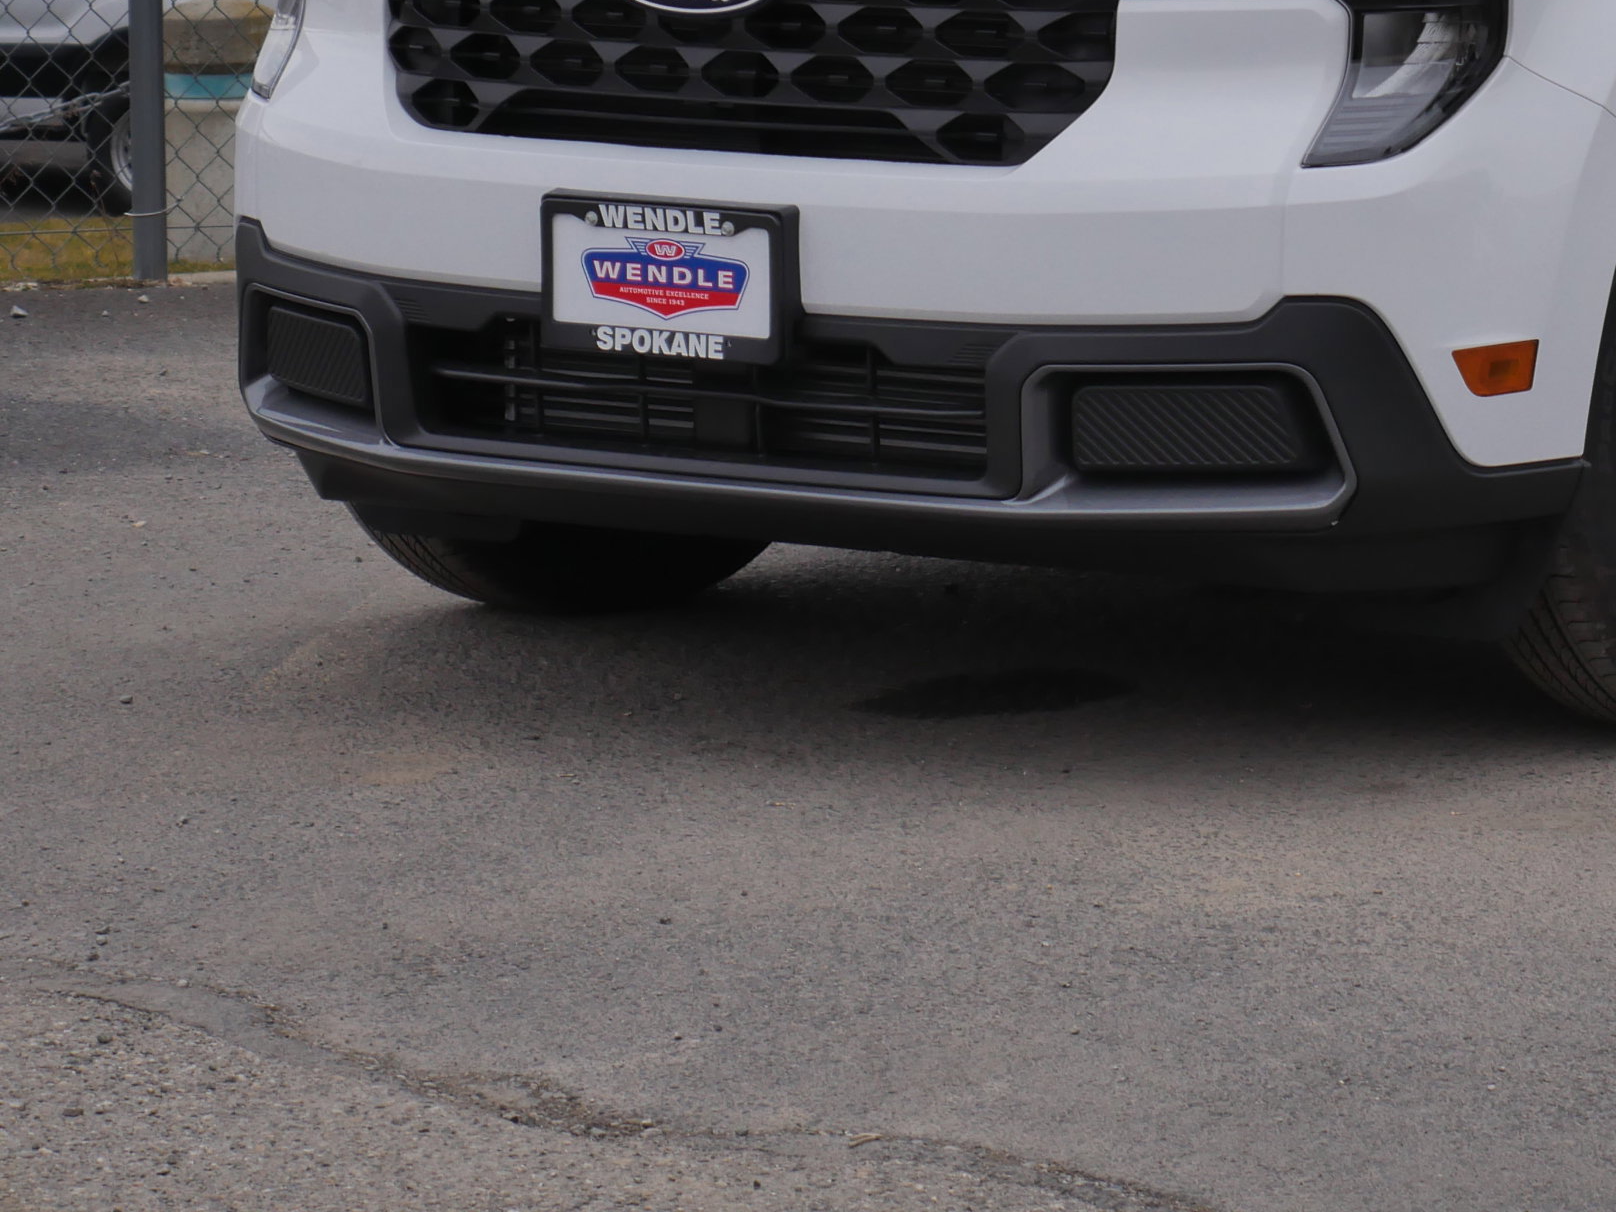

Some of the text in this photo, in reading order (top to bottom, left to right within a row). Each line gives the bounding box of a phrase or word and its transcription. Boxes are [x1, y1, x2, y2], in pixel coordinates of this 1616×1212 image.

[598, 204, 723, 236] WENDLE
[592, 259, 735, 289] WENDLE
[619, 286, 710, 300] AUTOMOTIVE EXCELLENCE
[646, 296, 685, 306] SINCE 1943
[596, 326, 725, 360] SPOKANE
